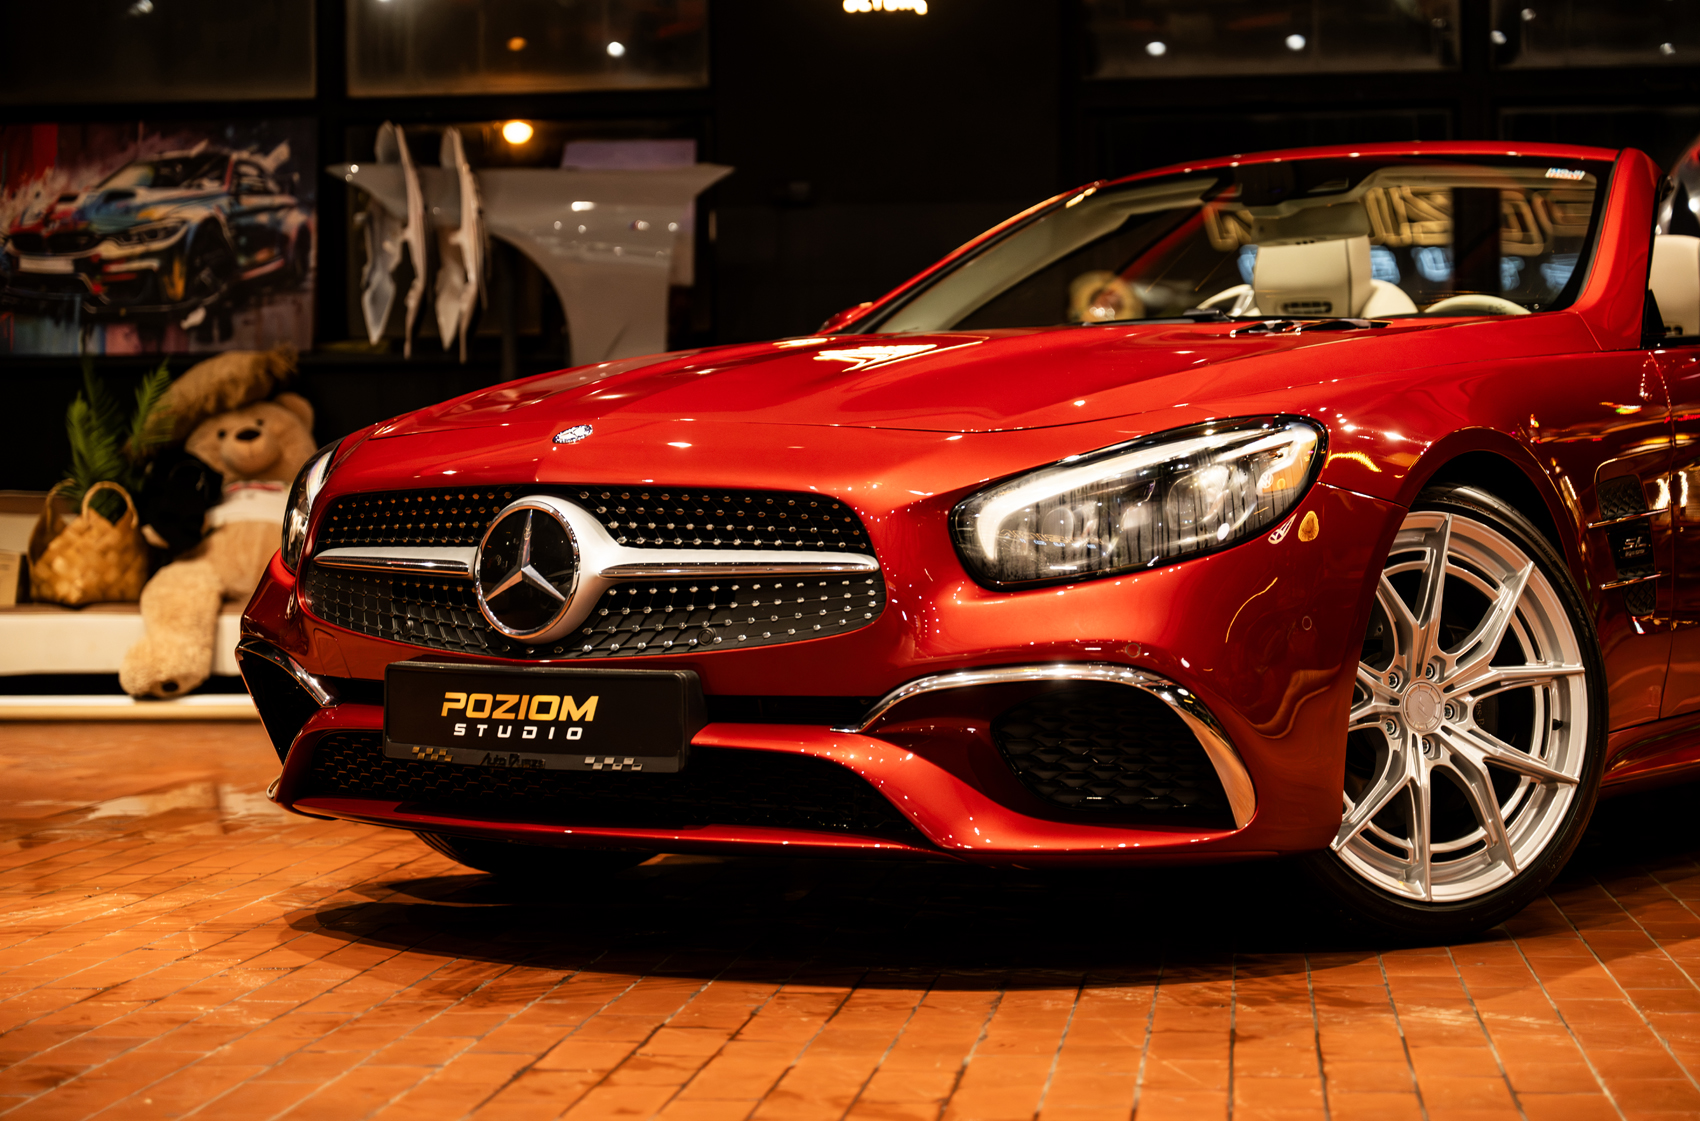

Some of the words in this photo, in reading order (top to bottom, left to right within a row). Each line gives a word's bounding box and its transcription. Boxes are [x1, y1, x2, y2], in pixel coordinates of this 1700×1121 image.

[1622, 536, 1647, 551] SL
[441, 692, 599, 722] POZIOM
[453, 723, 583, 741] STUDIO
